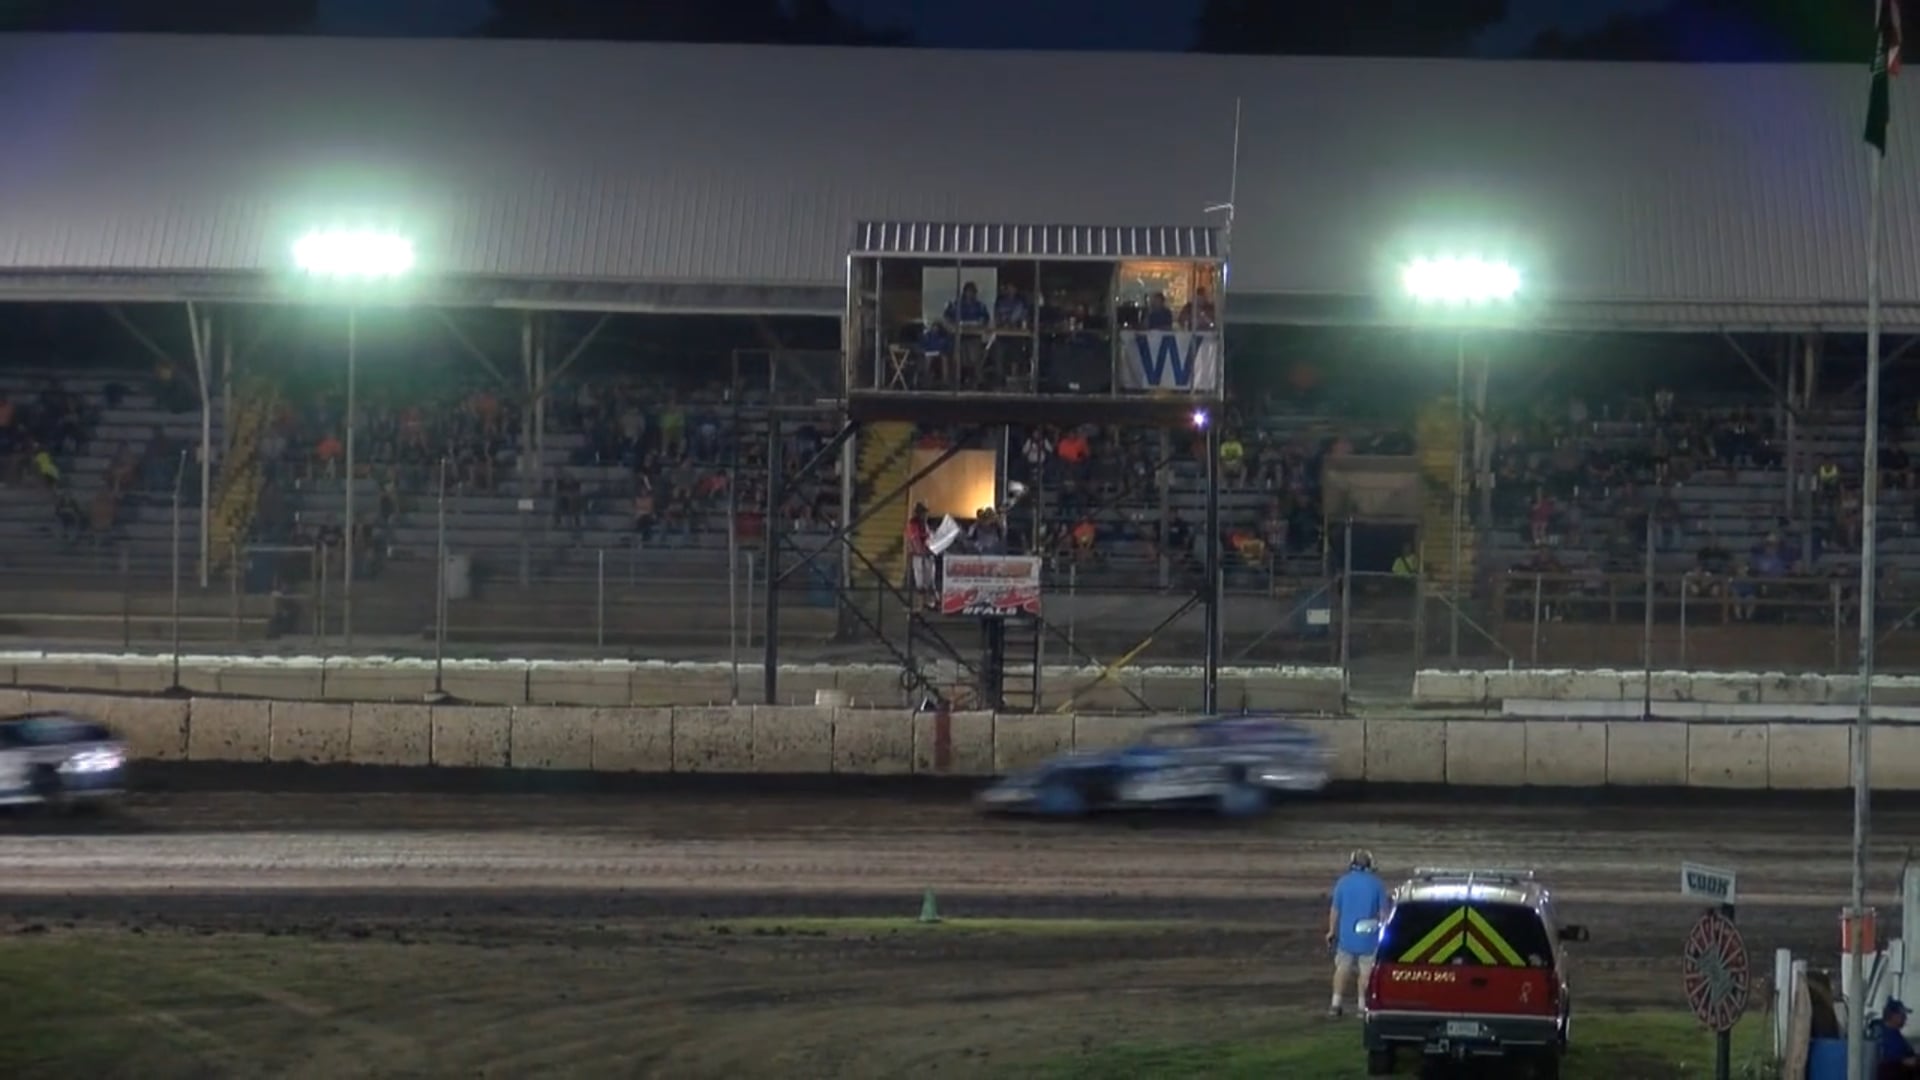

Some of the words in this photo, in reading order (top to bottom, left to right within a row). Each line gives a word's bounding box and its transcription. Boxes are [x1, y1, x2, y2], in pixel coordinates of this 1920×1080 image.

[1135, 334, 1204, 386] W
[1686, 871, 1730, 896] COOK
[1392, 969, 1432, 981] SQUAD
